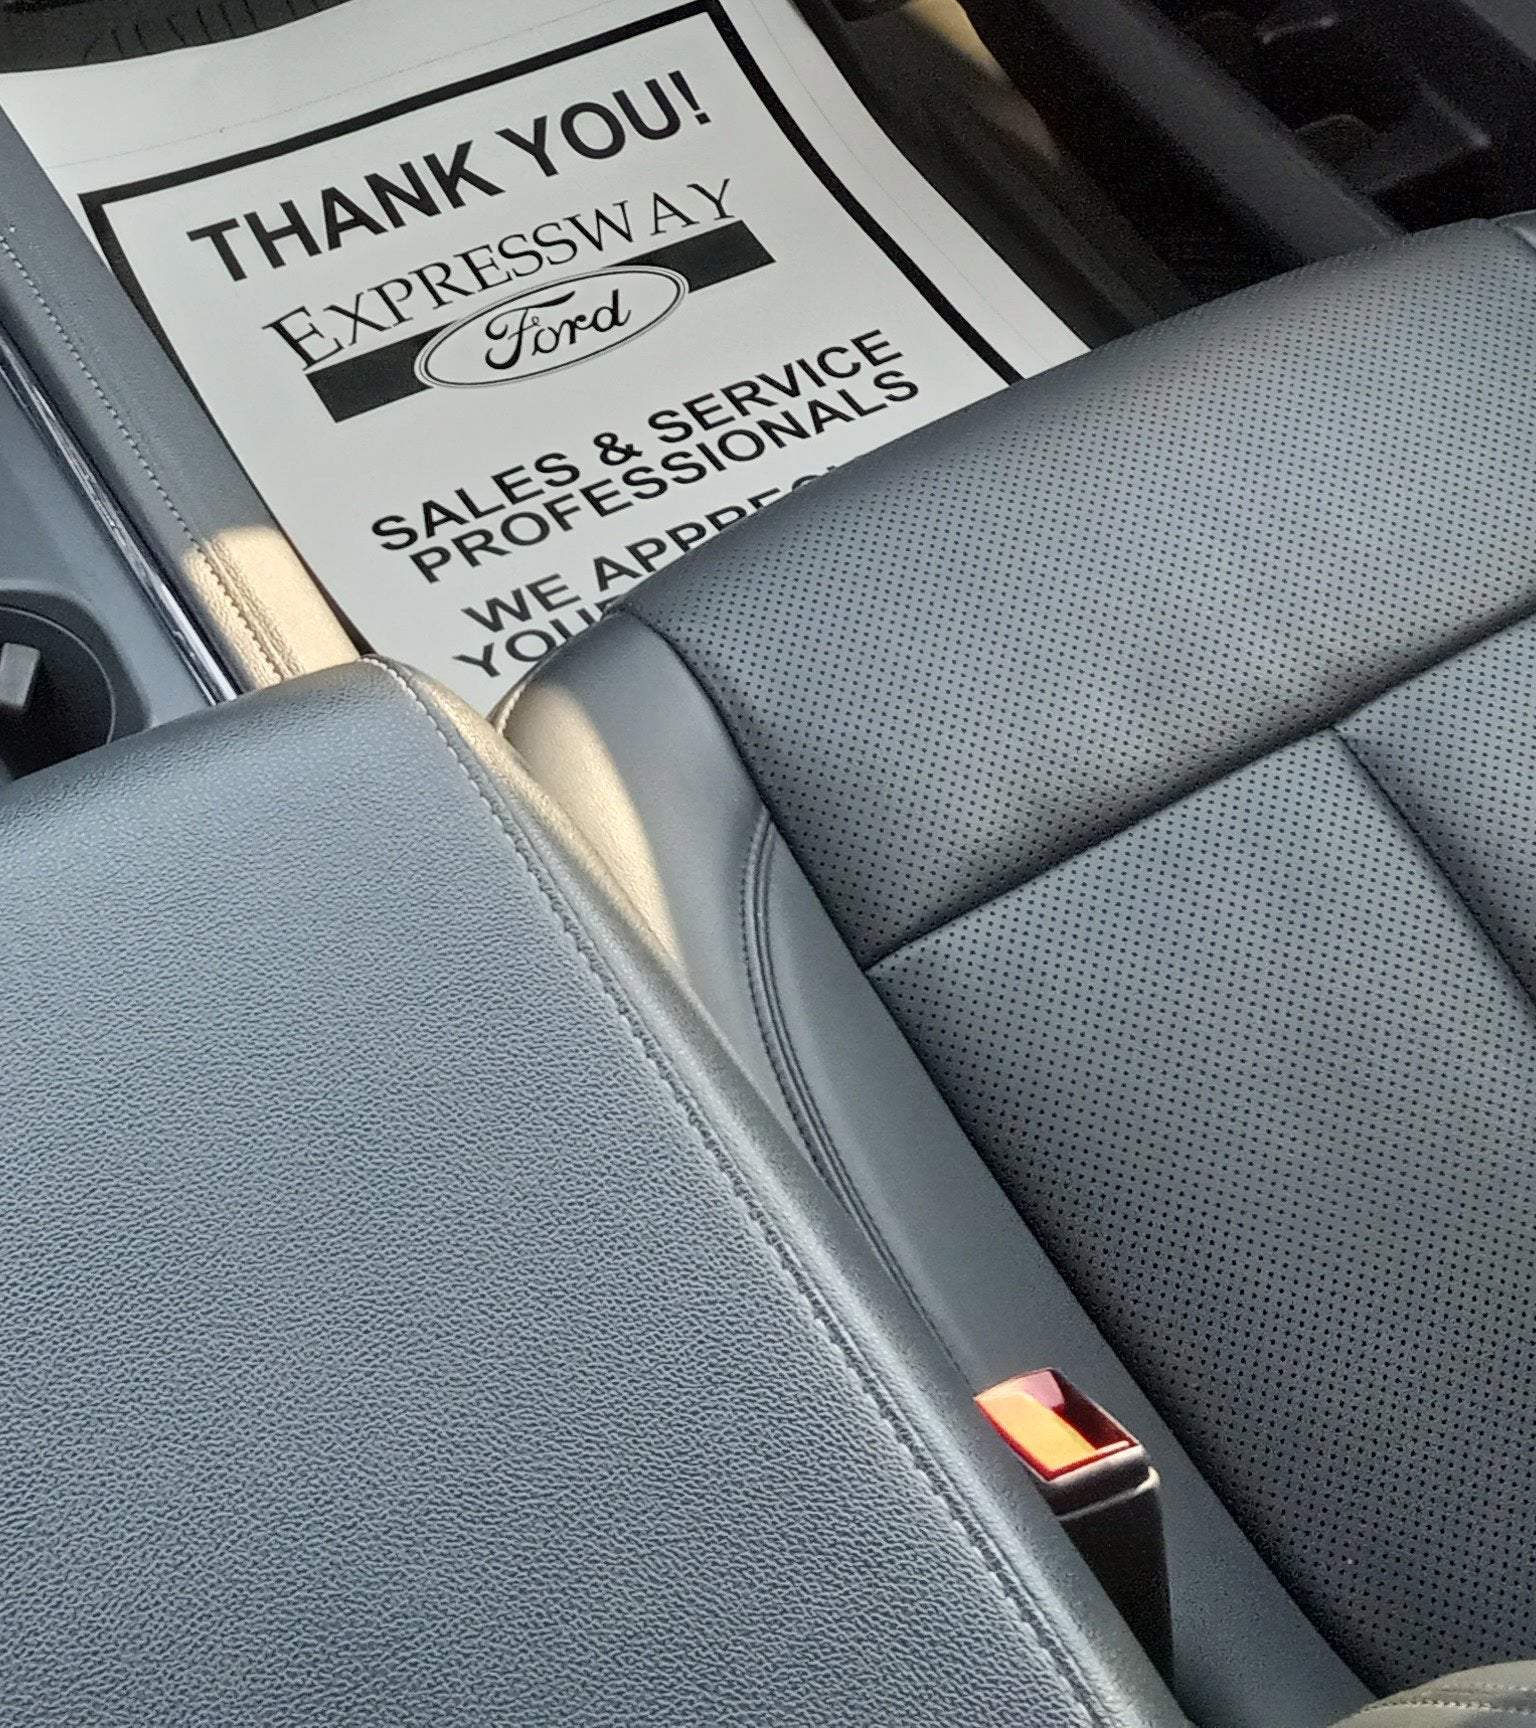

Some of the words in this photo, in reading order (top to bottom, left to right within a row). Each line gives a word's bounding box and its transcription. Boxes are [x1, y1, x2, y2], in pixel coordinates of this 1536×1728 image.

[187, 141, 508, 281] THANK
[496, 69, 712, 180] YOU!
[262, 176, 740, 369] EXPRESSWAY
[484, 289, 631, 372] Ford
[370, 452, 581, 551] SALES
[592, 431, 645, 467] &
[646, 328, 904, 443] SERVICE
[410, 369, 920, 582] PROFESSIONALS
[452, 598, 625, 679] YOU
[461, 573, 579, 633] WE
